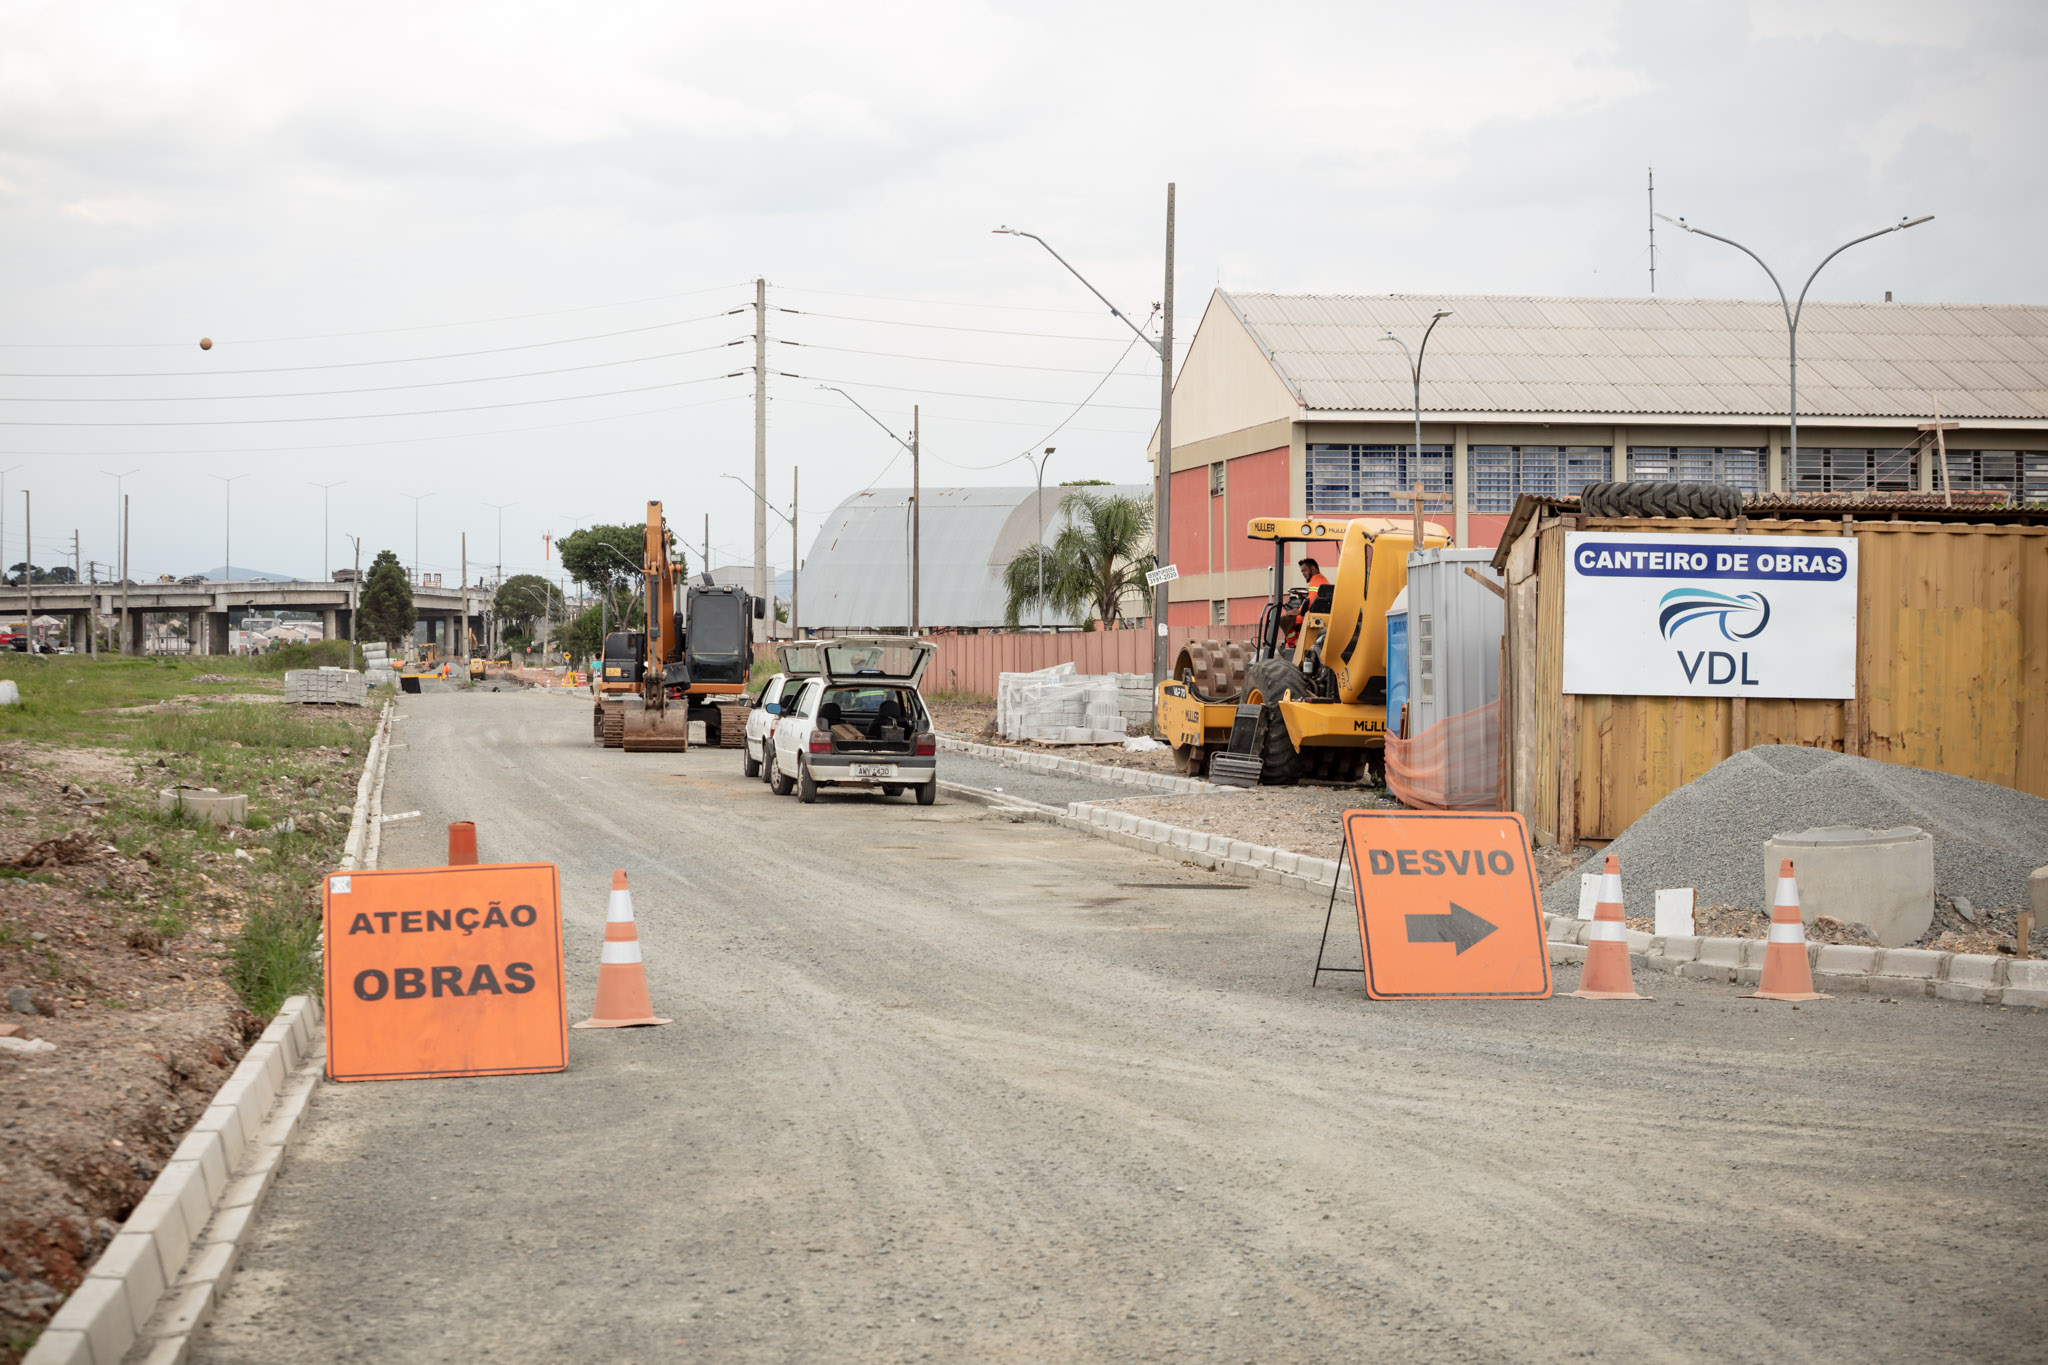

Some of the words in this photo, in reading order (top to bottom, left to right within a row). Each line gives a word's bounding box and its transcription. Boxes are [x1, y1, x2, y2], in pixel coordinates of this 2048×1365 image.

[1579, 550, 1708, 571] CANTEIRO
[1717, 553, 1749, 572] DE
[1757, 554, 1843, 574] OBRAS
[1149, 571, 1178, 585] 3191-2020
[1677, 650, 1759, 685] VDL
[1354, 720, 1386, 732] MÜLL
[1368, 850, 1515, 876] DESVIO
[348, 901, 537, 936] ATENÇÃO
[353, 962, 536, 1001] OBRAS
